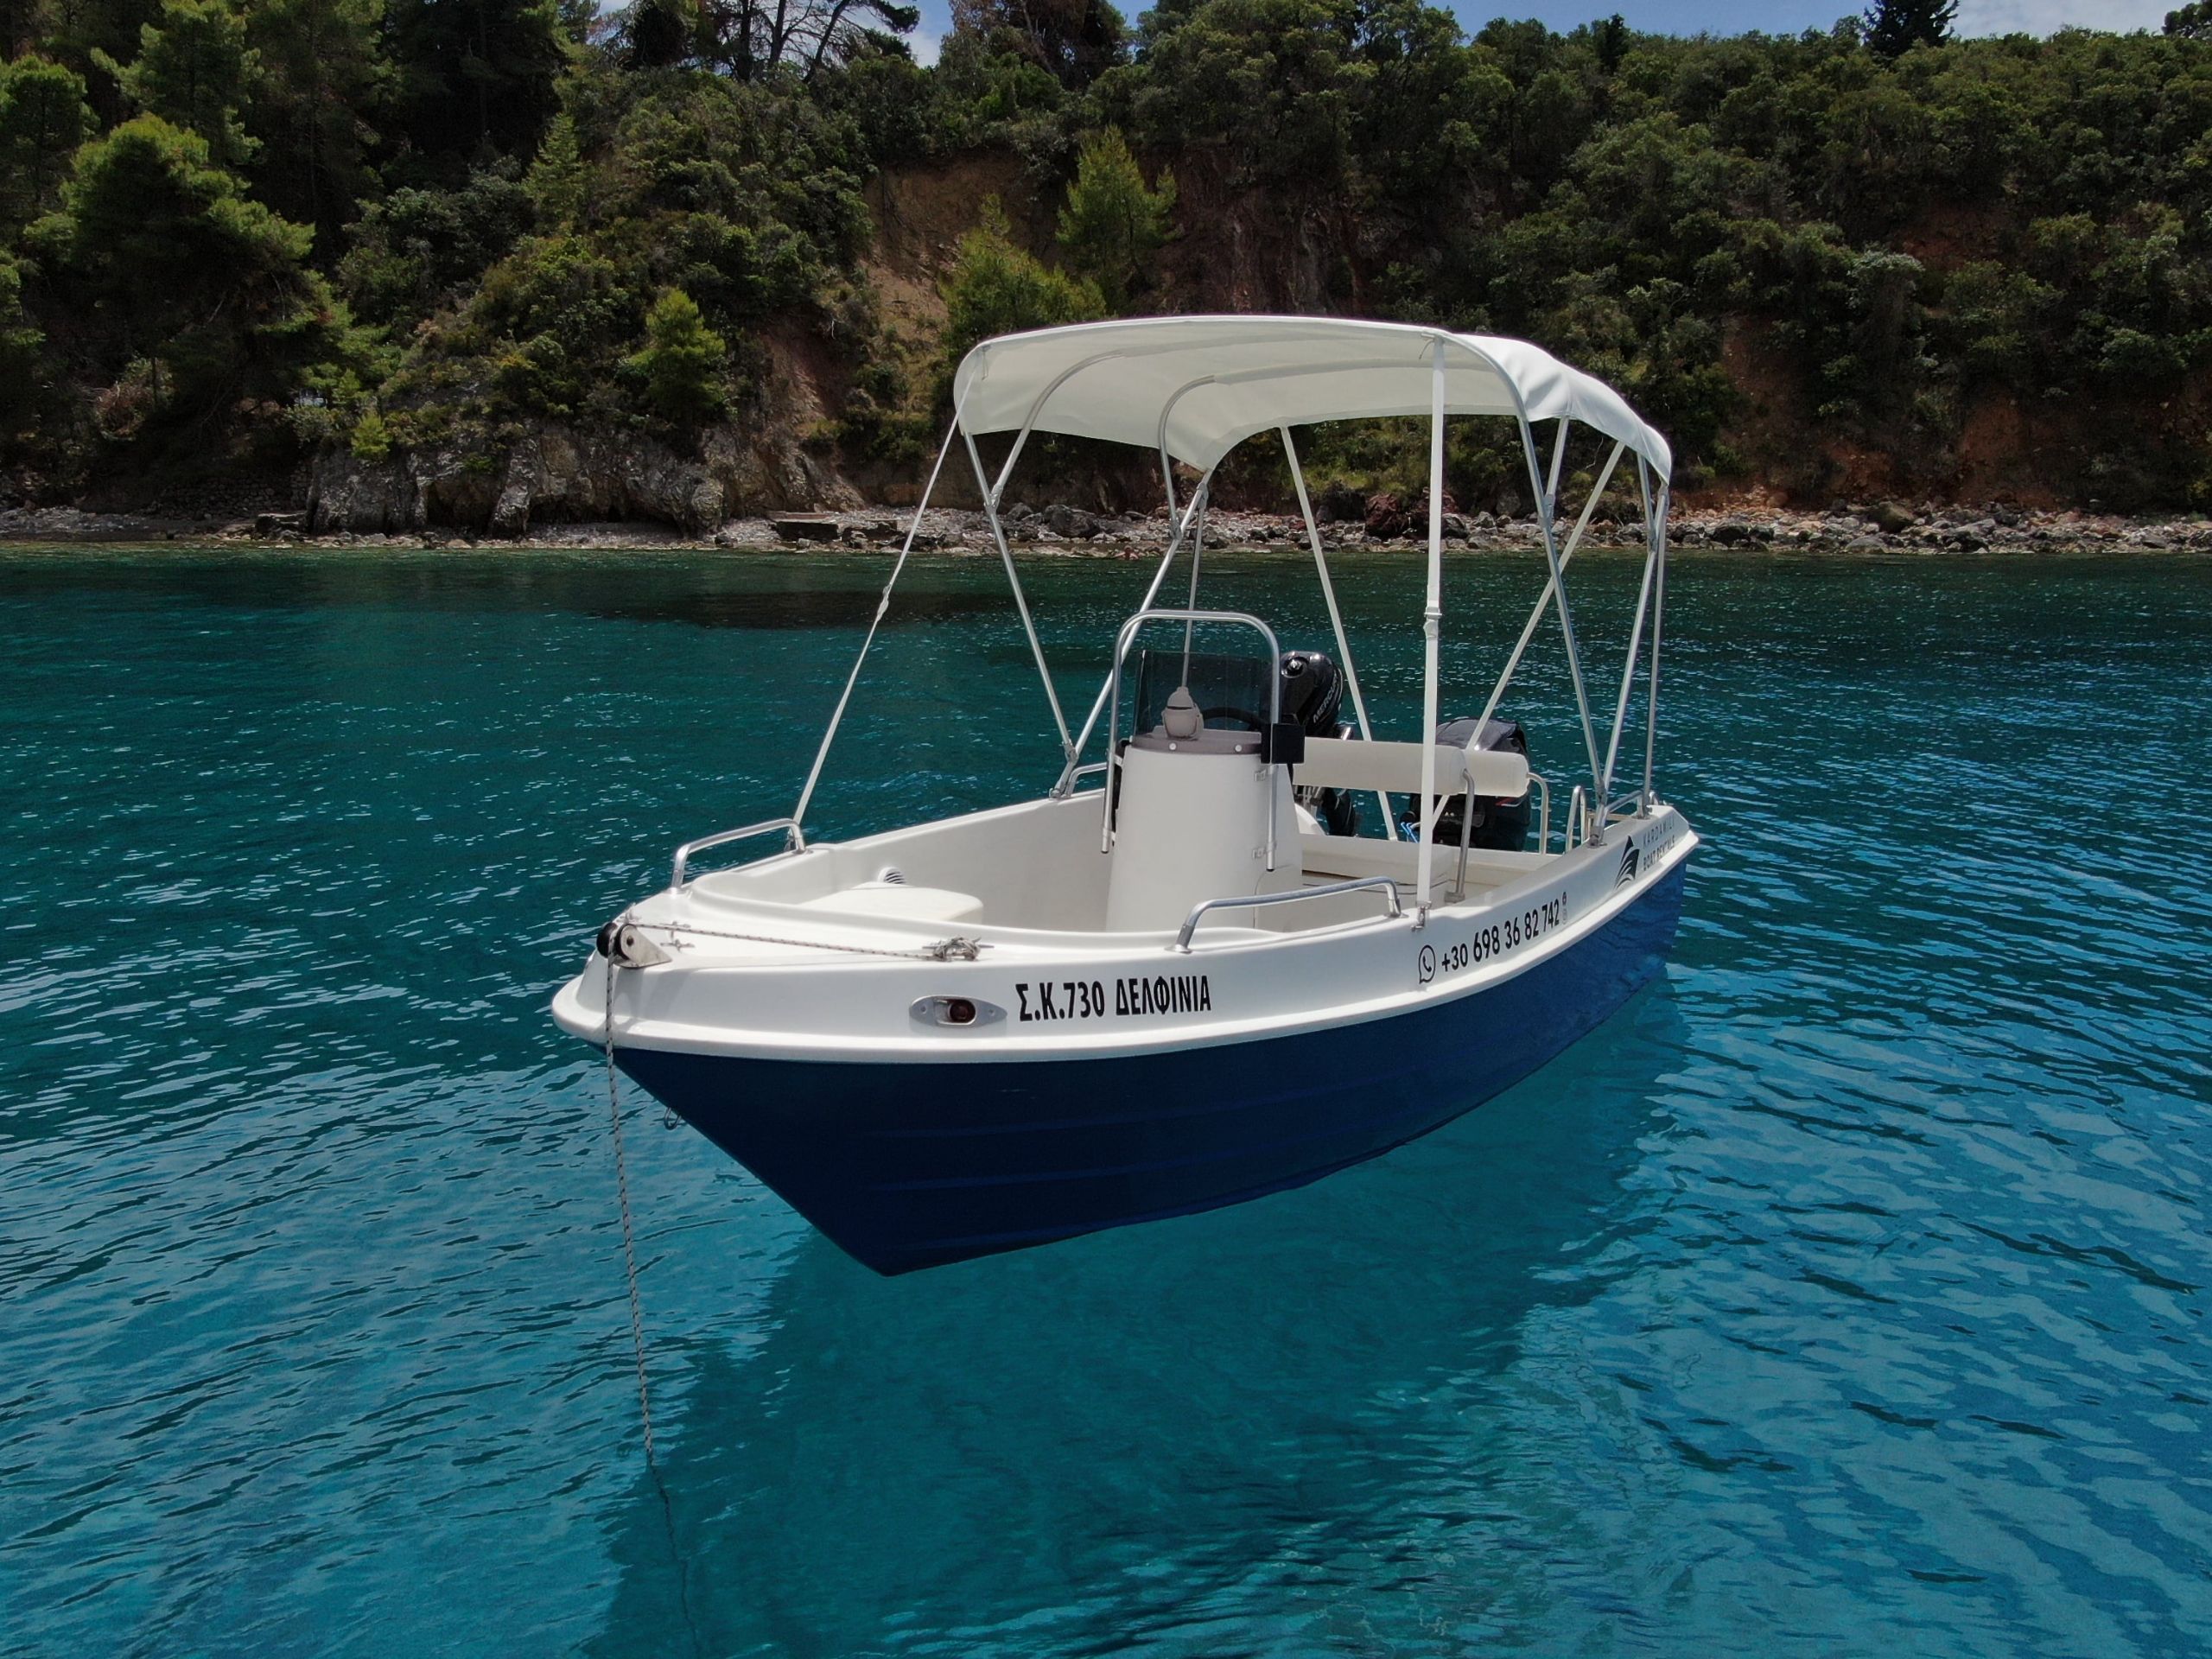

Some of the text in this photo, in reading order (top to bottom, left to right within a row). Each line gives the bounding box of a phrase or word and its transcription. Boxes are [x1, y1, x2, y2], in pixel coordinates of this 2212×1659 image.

[1441, 898, 1560, 972] +30 698 36 82 742
[1015, 976, 1211, 1021] Σ.Κ.730 ΔΕΛΦΙΝΙΑ
